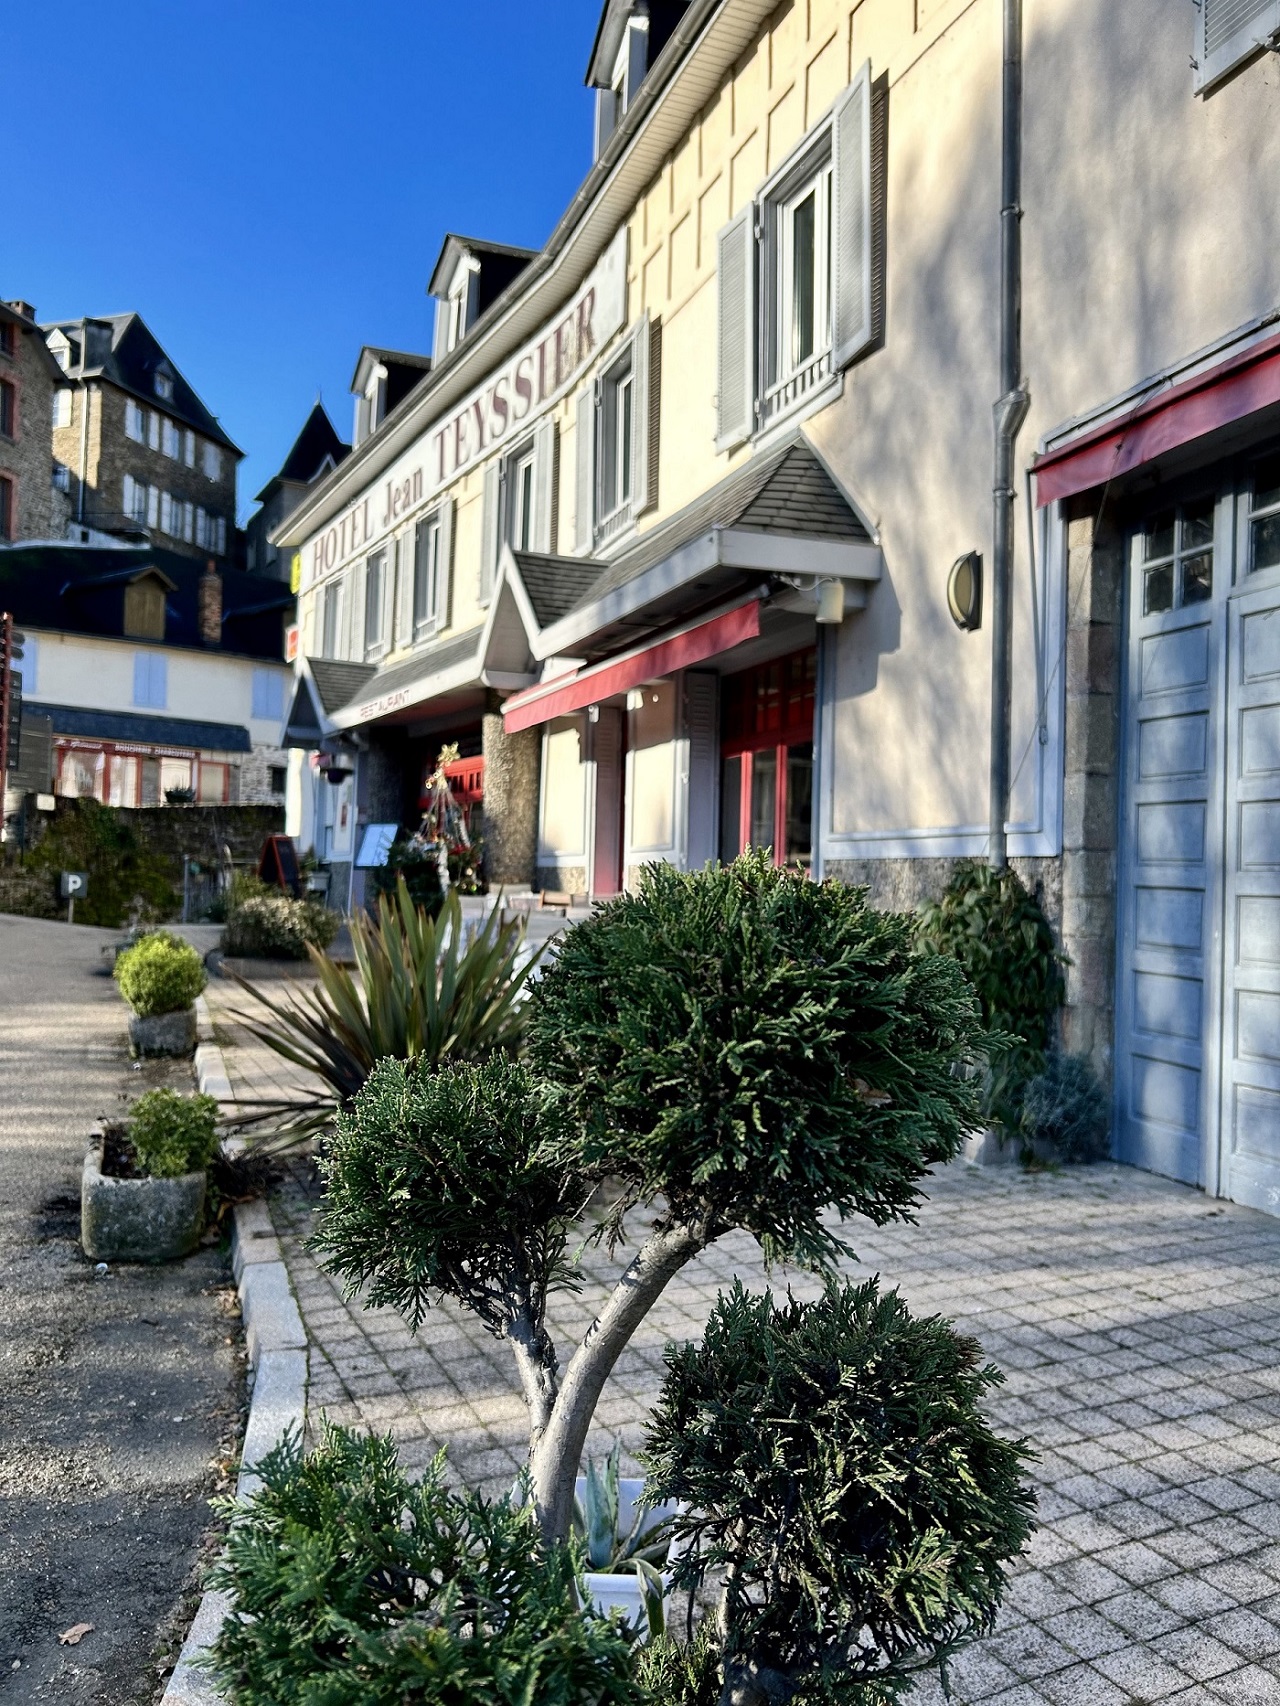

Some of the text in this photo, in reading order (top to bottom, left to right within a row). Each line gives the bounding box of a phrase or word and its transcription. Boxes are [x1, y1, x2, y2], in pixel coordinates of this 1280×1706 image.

[312, 496, 374, 581] HOTEL
[383, 467, 422, 528] Jean
[436, 286, 596, 484] TEYSSIER
[68, 874, 82, 894] P
